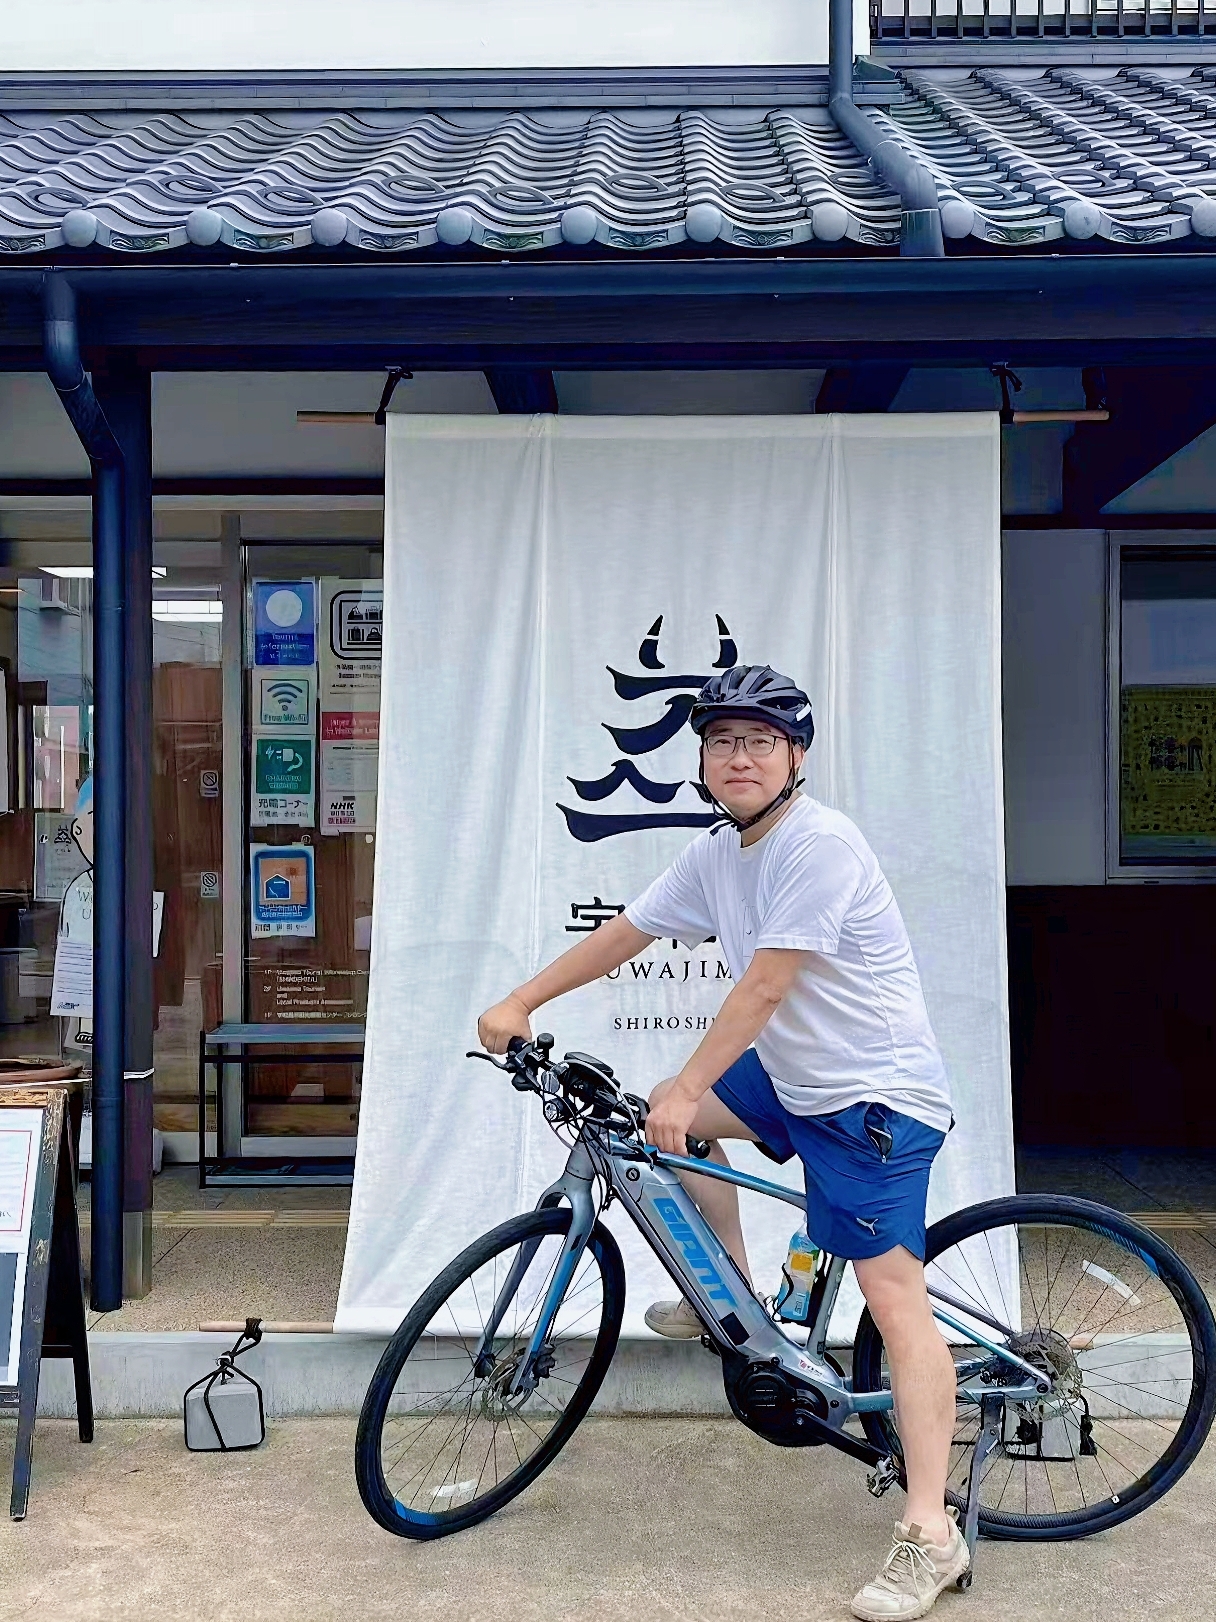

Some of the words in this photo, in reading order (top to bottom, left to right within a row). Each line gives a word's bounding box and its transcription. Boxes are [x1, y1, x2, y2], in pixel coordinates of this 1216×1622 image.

[330, 802, 355, 810] NHK
[613, 1016, 715, 1030] SHIROSH
[653, 1197, 739, 1309] GIANT
